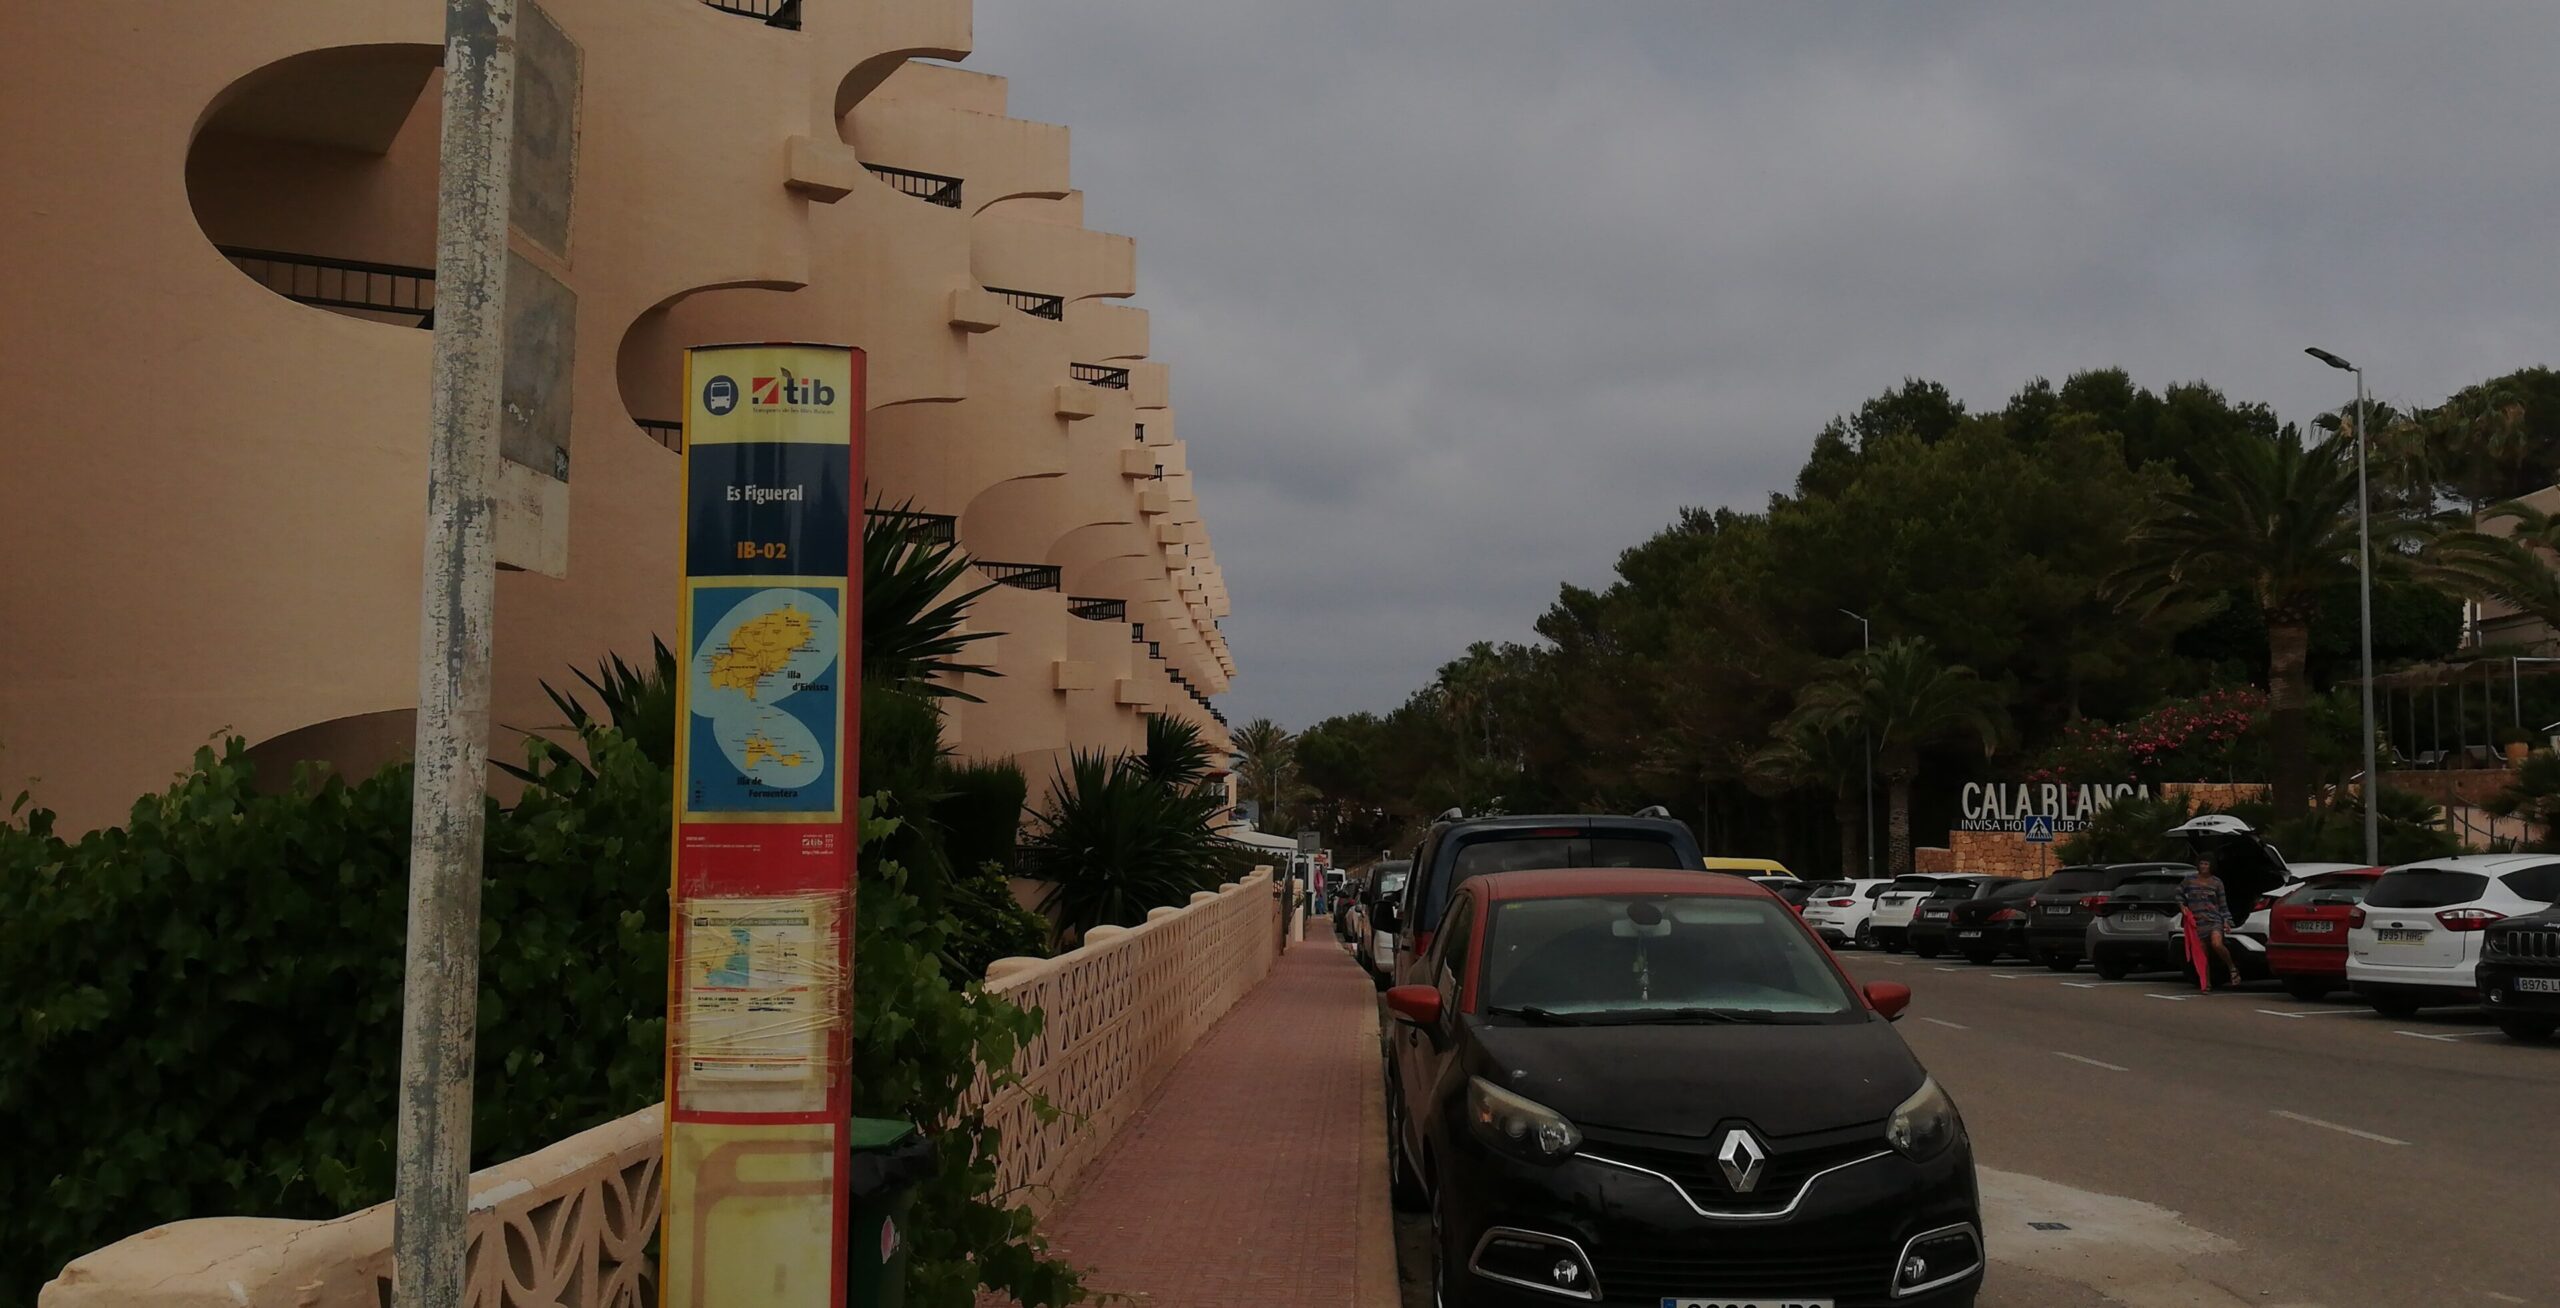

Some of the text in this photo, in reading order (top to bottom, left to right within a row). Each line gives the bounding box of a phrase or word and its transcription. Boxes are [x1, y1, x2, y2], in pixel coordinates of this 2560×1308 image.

[783, 378, 835, 406] tib
[727, 485, 803, 504] Es Figueral
[737, 541, 787, 559] IB-02
[1961, 781, 2033, 820] CALA
[1961, 820, 2001, 831] INVISA
